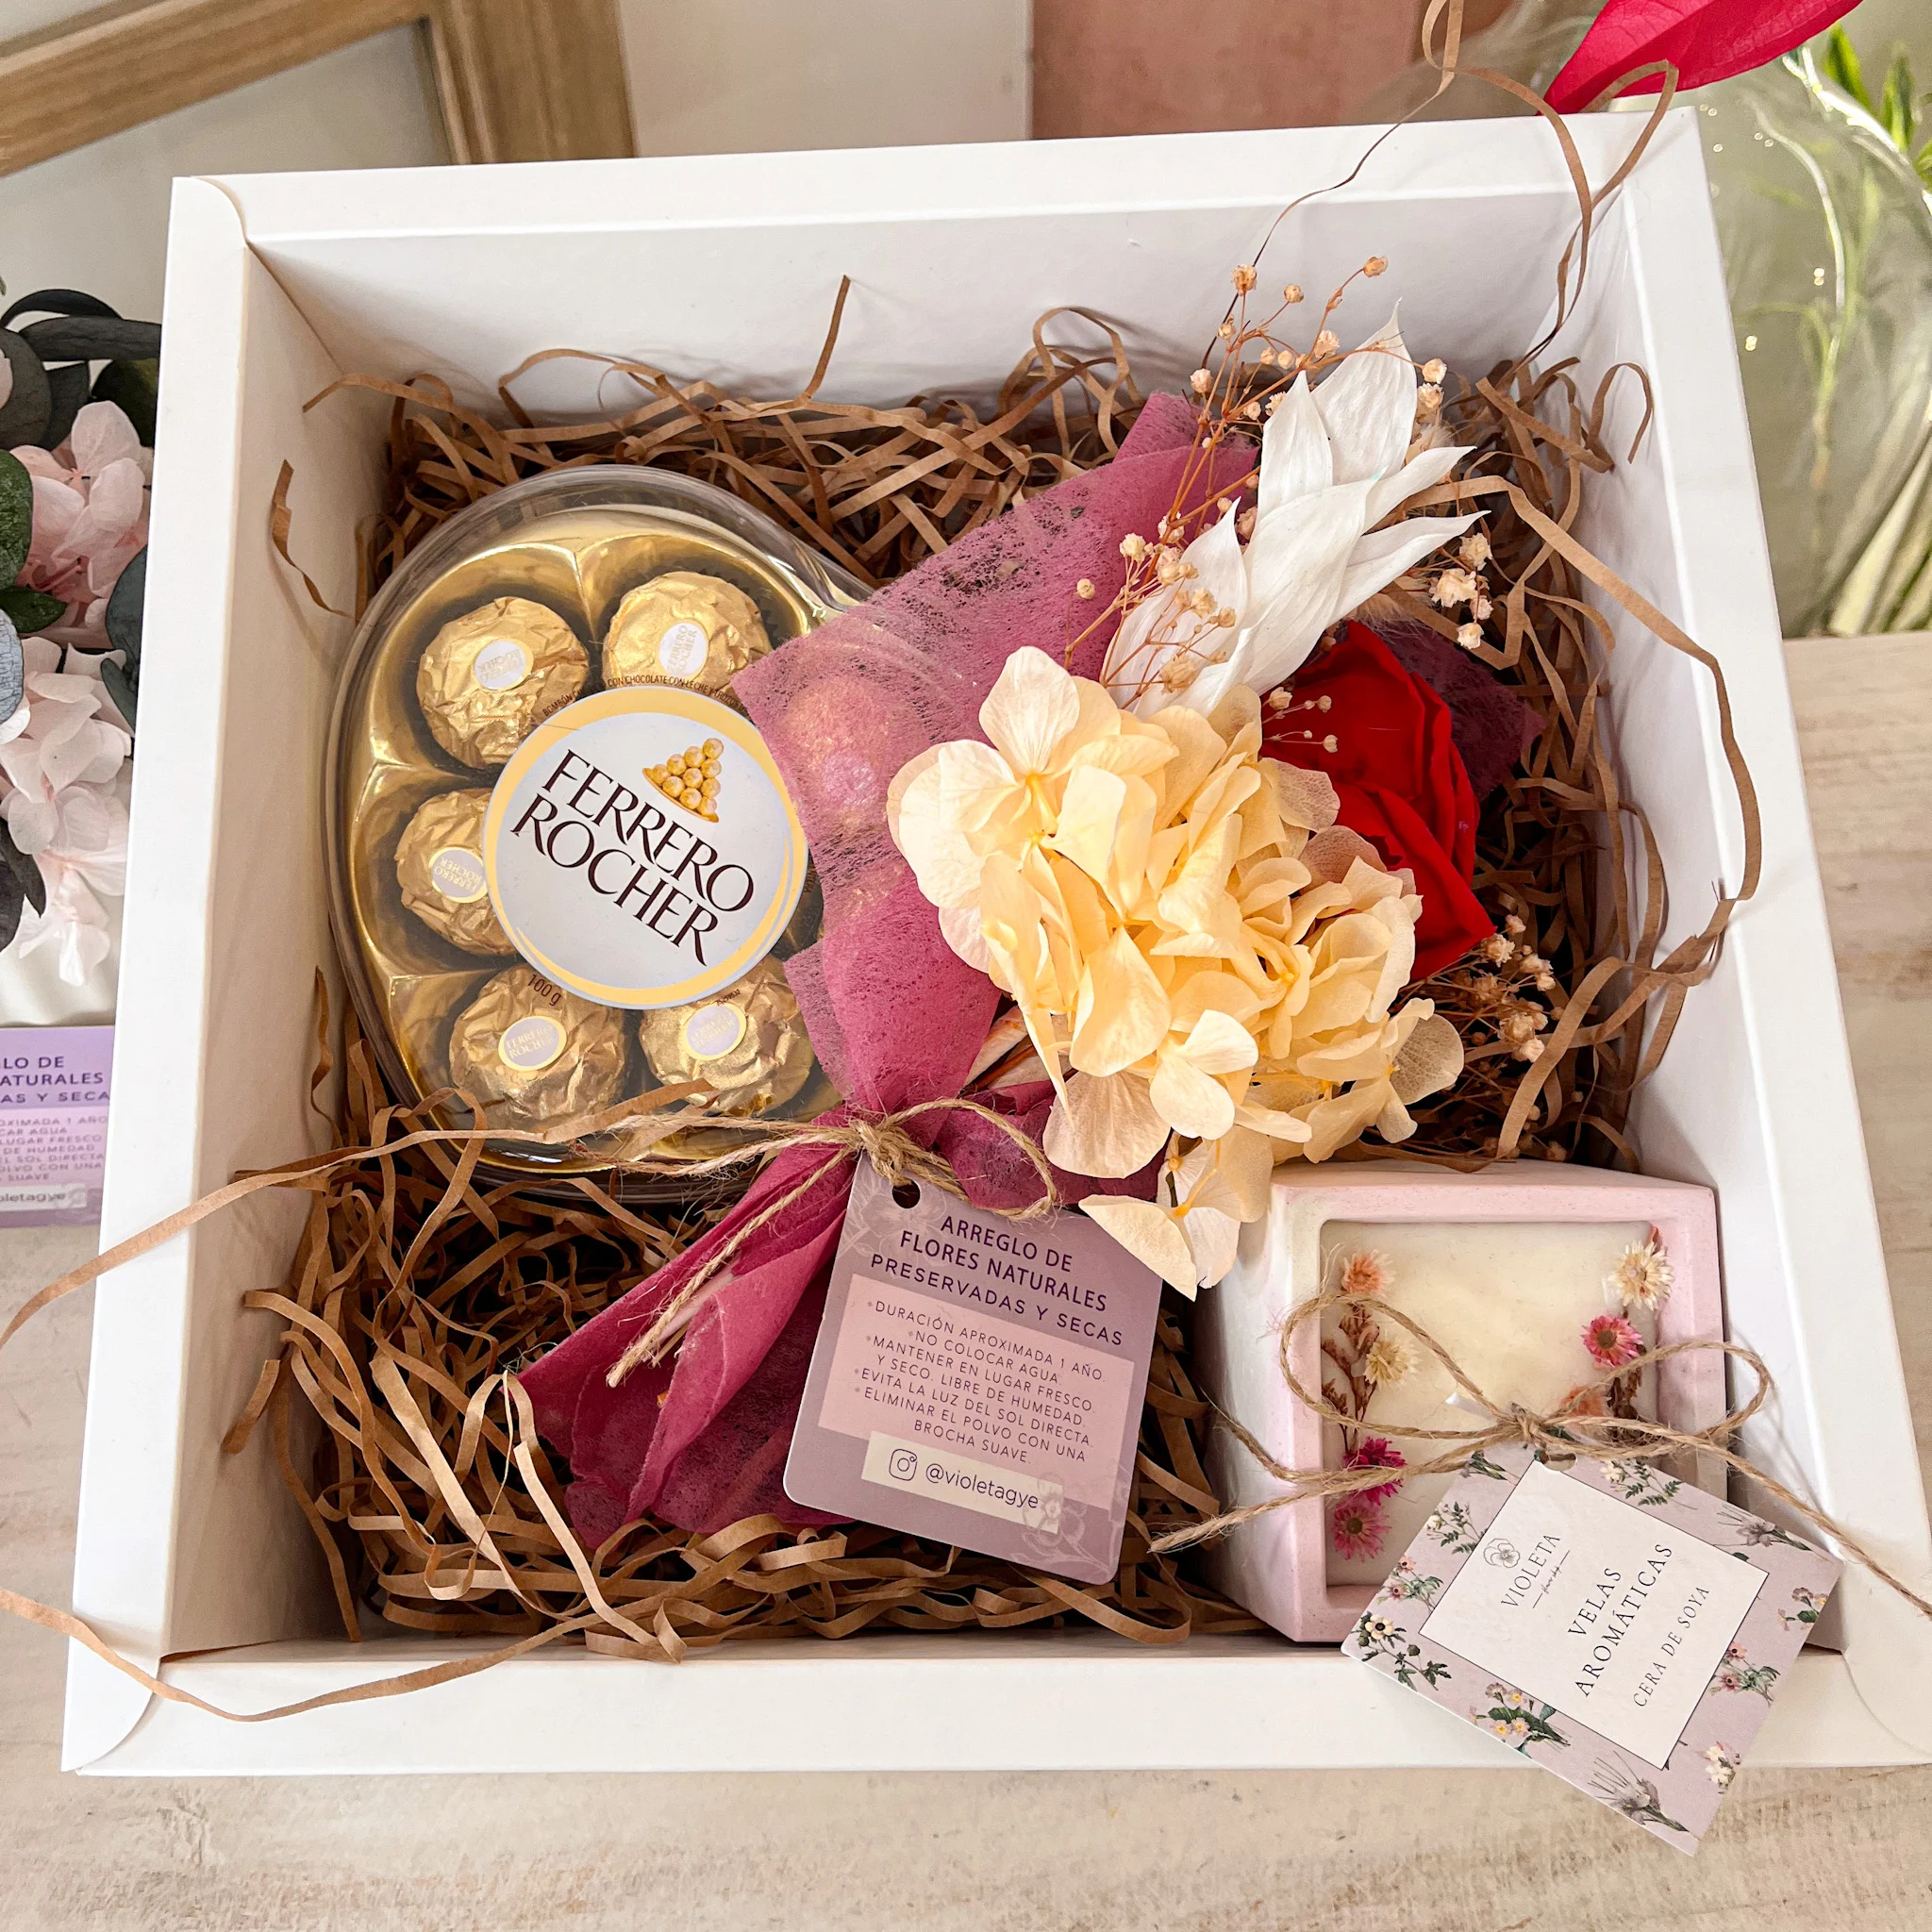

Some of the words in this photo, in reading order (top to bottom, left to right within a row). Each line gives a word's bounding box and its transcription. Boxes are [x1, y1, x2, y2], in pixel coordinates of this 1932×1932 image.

[608, 676, 623, 687] CON
[625, 675, 667, 684] CHOCOLATE
[669, 676, 685, 687] CON
[686, 680, 708, 692] LECHE
[541, 748, 755, 912] FERRERO
[435, 866, 478, 892] FERRERO
[441, 857, 482, 883] ROCHER
[509, 793, 719, 967] ROCHER
[528, 974, 553, 997] 100
[549, 992, 561, 1006] g
[507, 1025, 553, 1049] FERRERO
[509, 1035, 552, 1058] ROCHER
[0, 1072, 104, 1086] ATURALES
[3, 1057, 29, 1069] LO
[38, 1056, 65, 1068] DE
[0, 1093, 25, 1103] AS
[38, 1092, 48, 1102] Y
[58, 1091, 110, 1102] SECA
[3, 1146, 20, 1155] DE
[27, 1143, 94, 1154] HUMEDAD
[17, 1155, 42, 1163] SOL
[48, 1153, 104, 1163] DIRECTA
[75, 1161, 101, 1170] UNA
[941, 1215, 1038, 1259] ARREGLO
[1045, 1248, 1073, 1273] DE
[900, 1230, 979, 1271] FLORES
[987, 1257, 1107, 1312] NATURALES
[871, 1254, 1025, 1315] PRESERVADAS
[1036, 1305, 1049, 1321] Y
[1057, 1313, 1123, 1346] SECAS
[875, 1301, 954, 1334] DURACIÓN
[959, 1327, 1054, 1365] APROXIMADA
[1060, 1358, 1065, 1369] 1
[915, 1330, 938, 1346] NO
[944, 1340, 1014, 1370] COLOCAR
[874, 1336, 954, 1369] MANTENER
[959, 1361, 978, 1376] EN
[984, 1369, 1032, 1392] LUGAR
[877, 1354, 885, 1365] Y
[941, 1374, 981, 1395] LIBRE
[986, 1388, 1005, 1403] DE
[861, 1368, 902, 1389] EVITA
[908, 1382, 925, 1396] LA
[932, 1389, 959, 1407] LUZ
[964, 1398, 991, 1416] DEL
[997, 1408, 1024, 1426] SOL
[865, 1387, 935, 1417] ELIMINAR
[941, 1409, 957, 1424] EL
[963, 1416, 1011, 1440] POLVO
[1018, 1432, 1050, 1451] CON
[1057, 1444, 1085, 1462] UNA
[914, 1419, 975, 1447] BROCHA
[925, 1463, 1039, 1508] @violetagye
[1500, 1535, 1560, 1607] VIOLETA
[1567, 1567, 1622, 1636] VELAS
[1574, 1543, 1673, 1697] AROMÁTICAS
[1633, 1661, 1667, 1707] CERA
[1660, 1631, 1683, 1657] DE
[1677, 1586, 1709, 1629] SOYA
